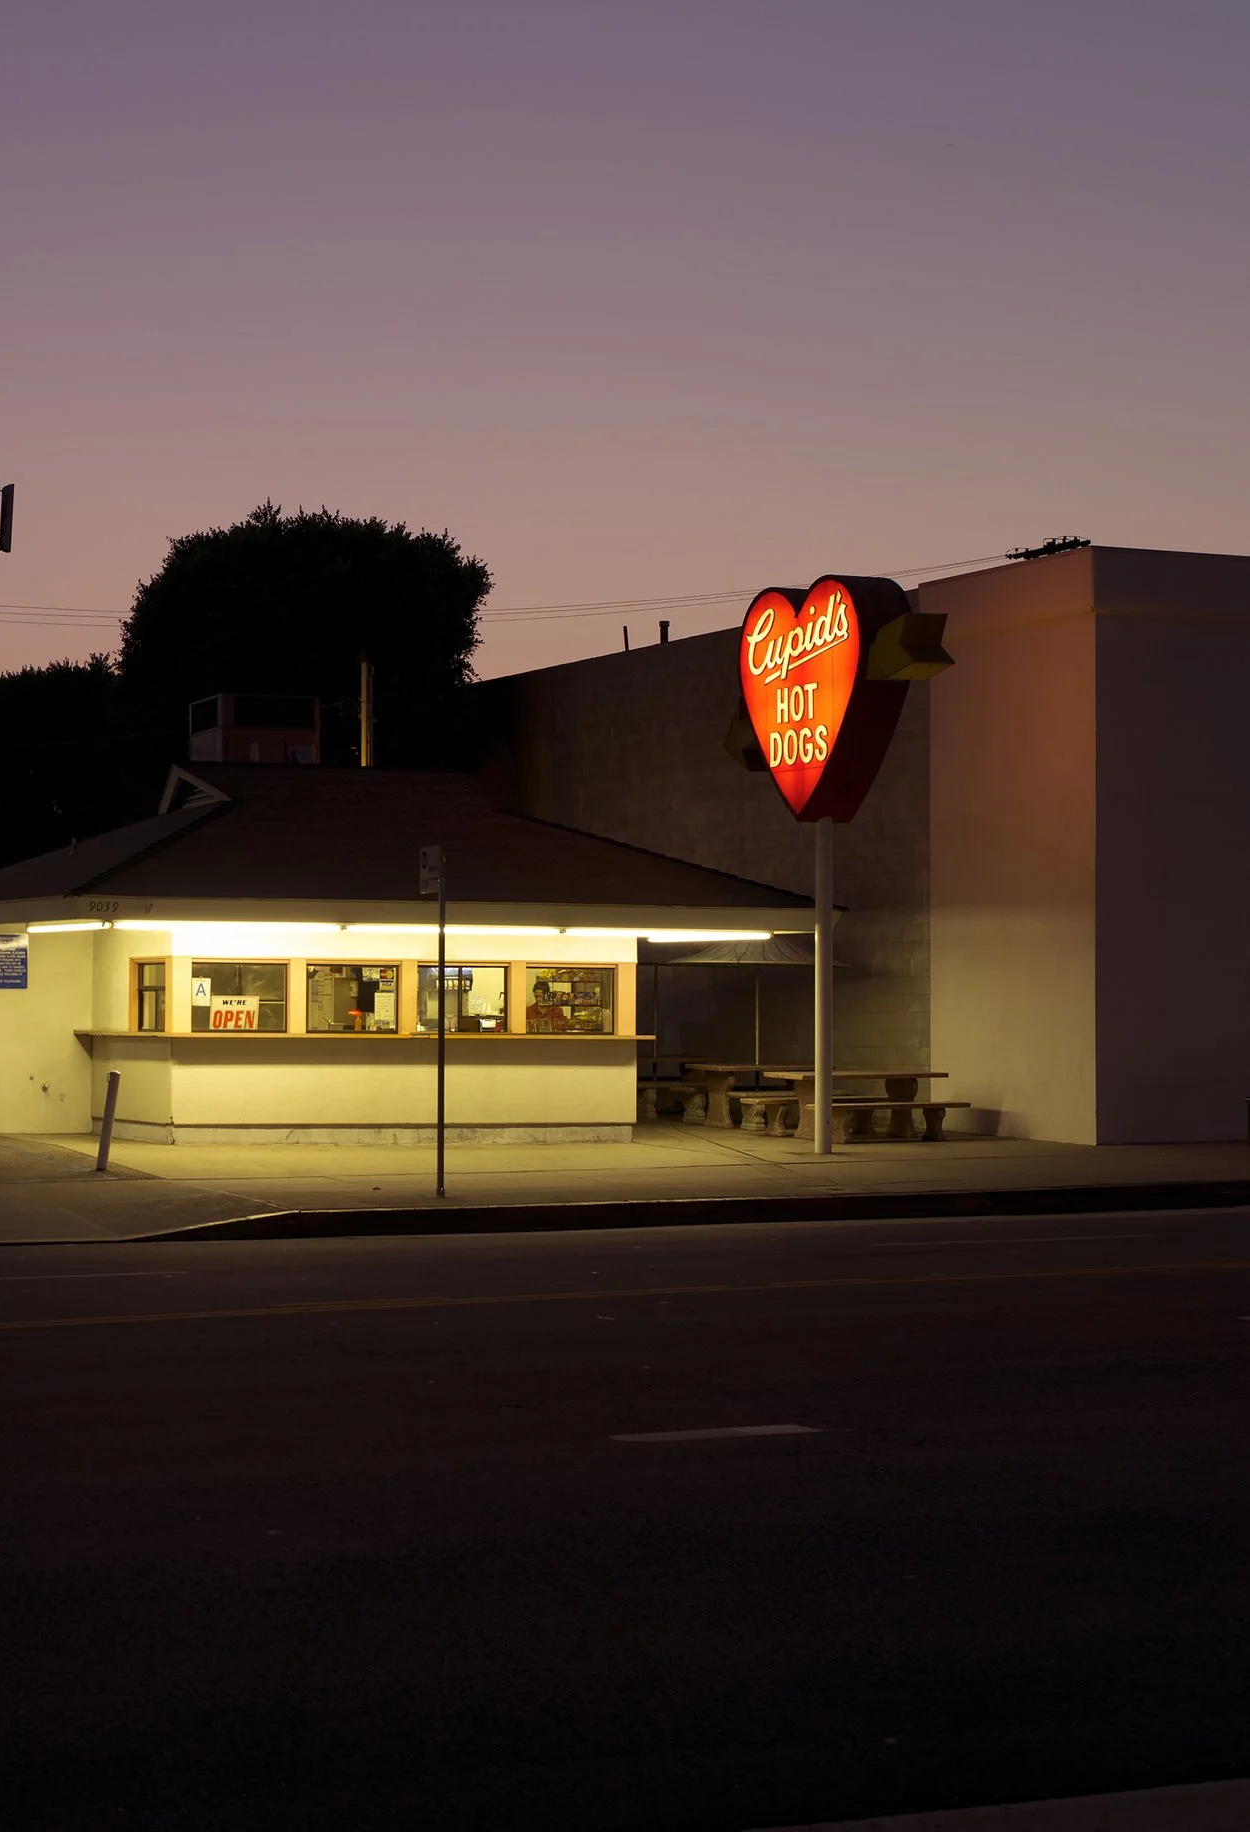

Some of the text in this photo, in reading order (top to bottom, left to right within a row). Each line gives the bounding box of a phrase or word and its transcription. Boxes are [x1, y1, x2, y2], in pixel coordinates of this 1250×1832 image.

[746, 590, 850, 680] Cupid's
[776, 682, 819, 724] HOT
[769, 725, 829, 768] DOGS
[88, 901, 120, 913] 9039
[195, 983, 206, 996] A
[212, 1009, 255, 1029] OPEN
